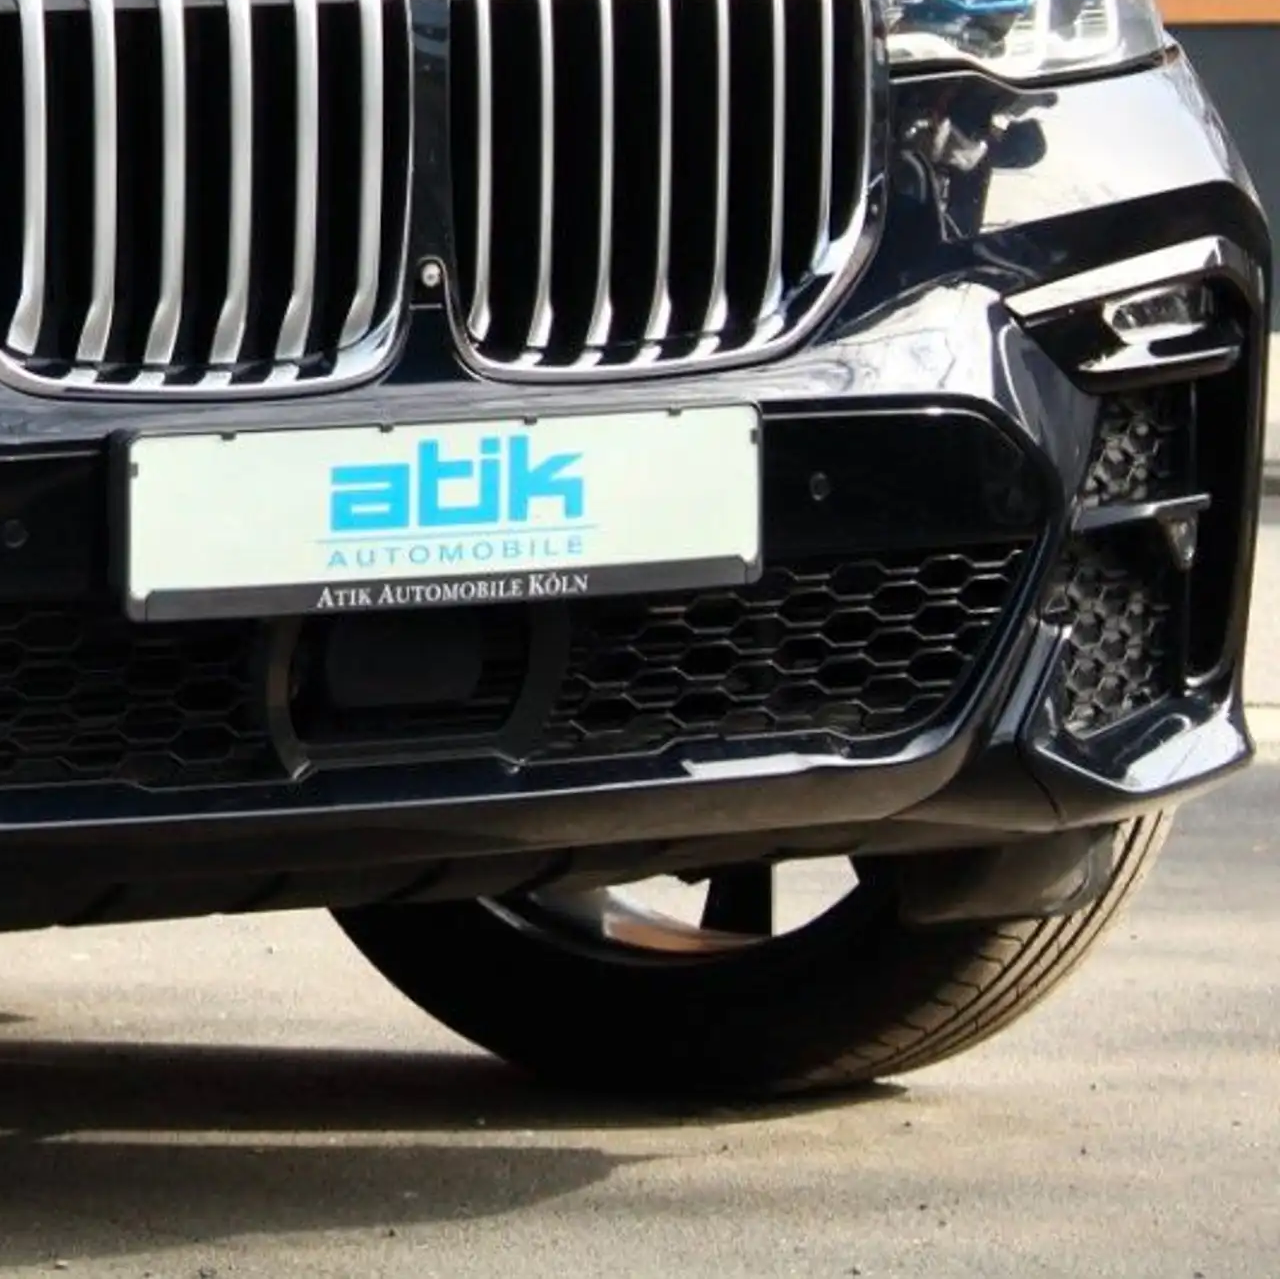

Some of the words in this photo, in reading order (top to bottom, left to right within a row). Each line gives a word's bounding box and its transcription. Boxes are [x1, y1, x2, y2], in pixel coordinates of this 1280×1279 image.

[330, 434, 583, 532] atik
[327, 536, 583, 569] AUTOMOBILE
[377, 578, 524, 605] AUTOMOBILE
[527, 572, 589, 597] KÖLN
